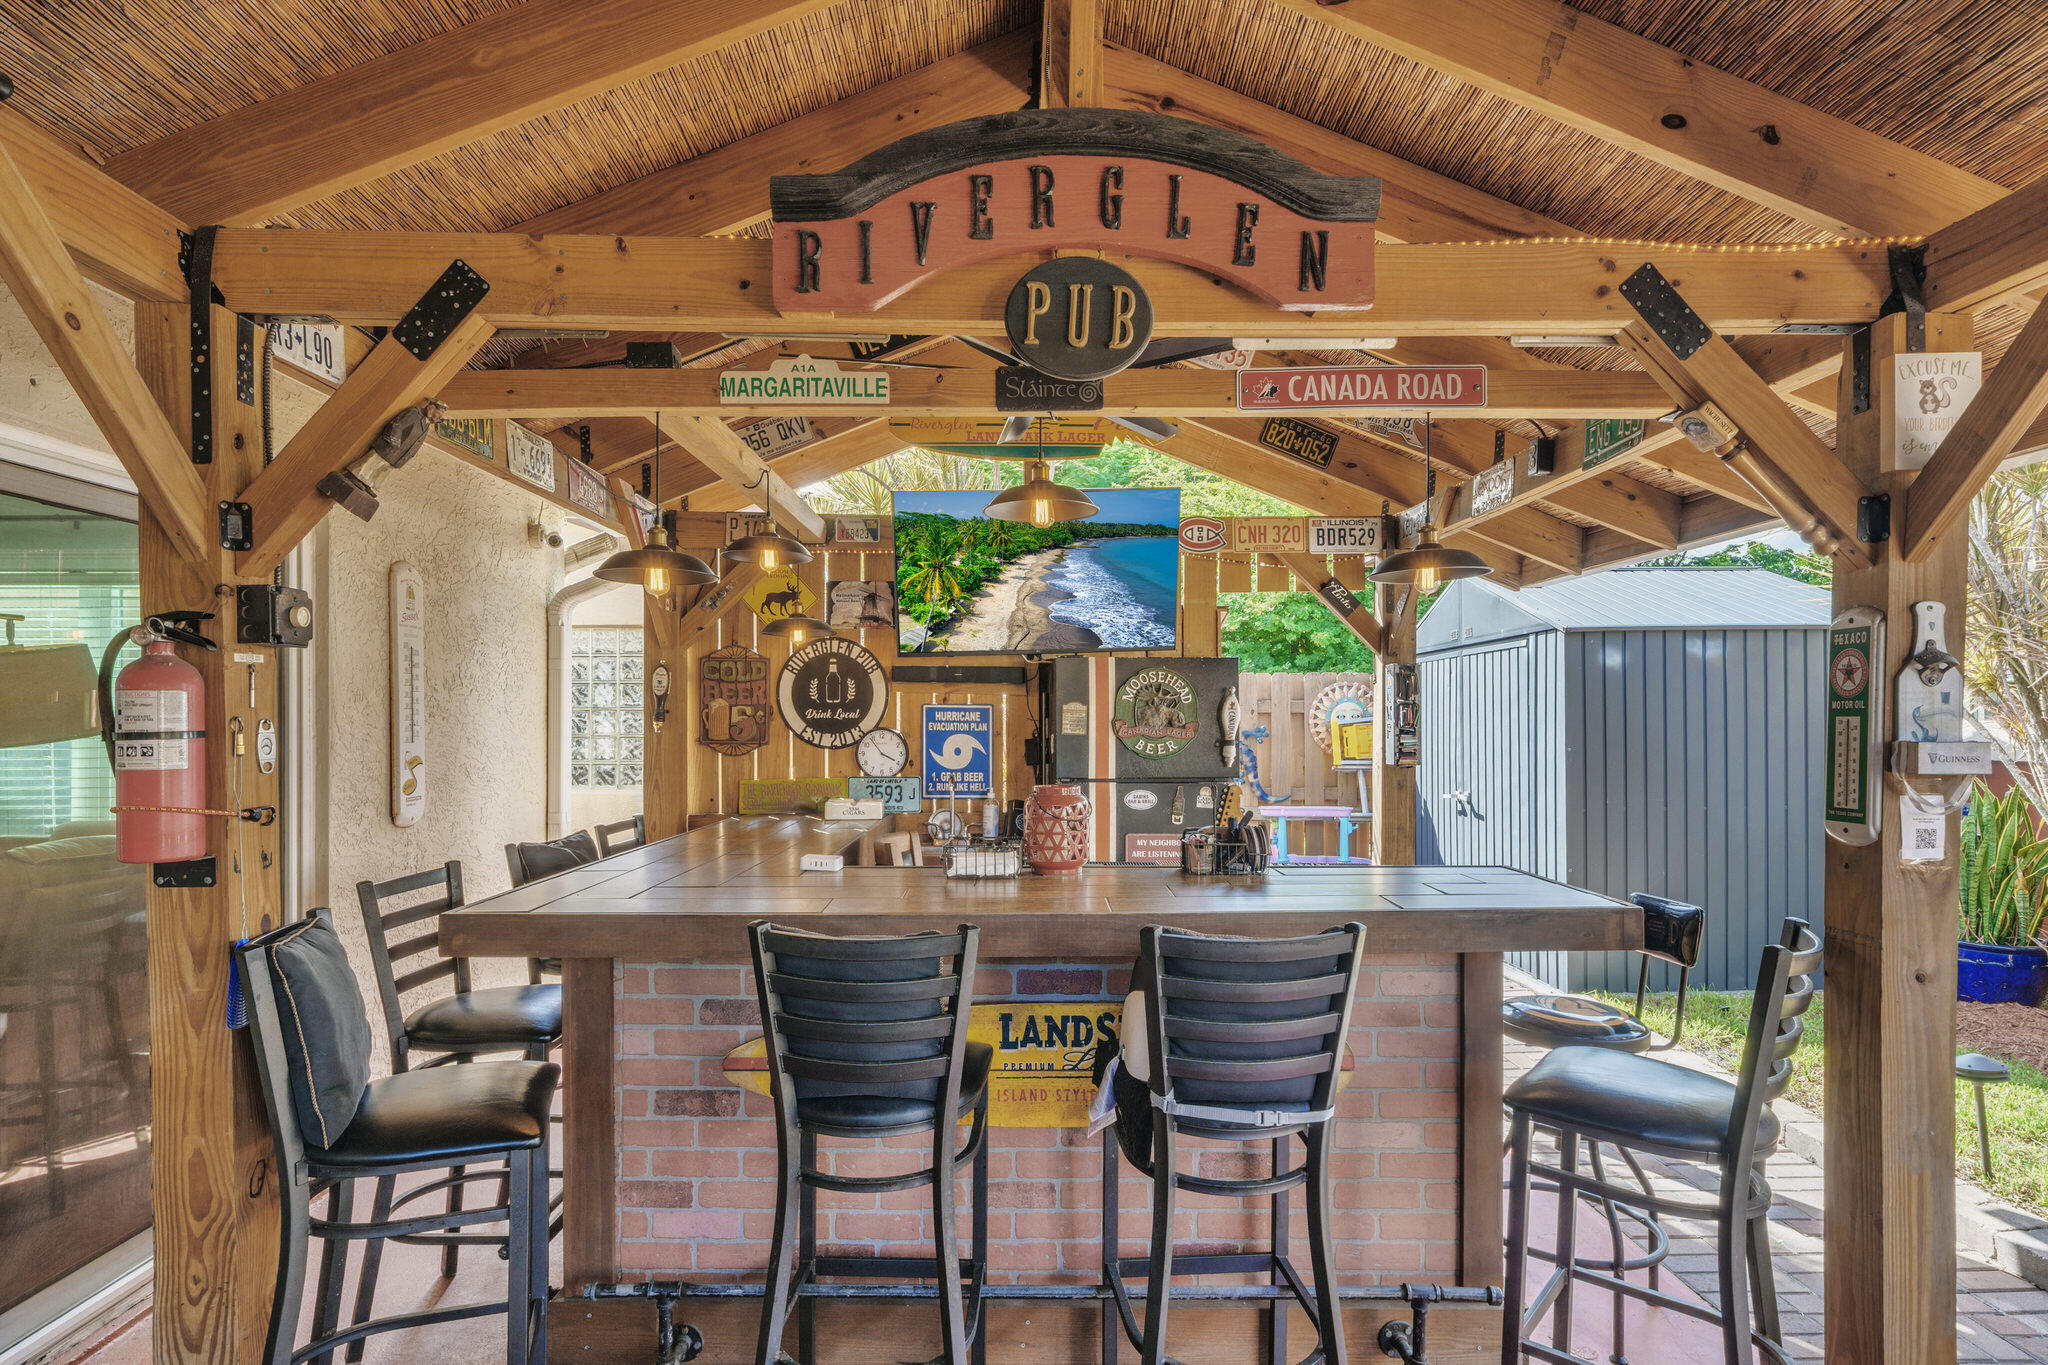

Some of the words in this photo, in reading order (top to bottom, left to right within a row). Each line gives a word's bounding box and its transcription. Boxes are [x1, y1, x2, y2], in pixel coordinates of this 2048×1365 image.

[796, 164, 1330, 294] RIVERGLEN
[1025, 280, 1137, 350] PUB
[791, 364, 816, 373] A1A
[1899, 357, 1946, 380] EXCUSE
[1950, 358, 1975, 380] ME
[721, 377, 887, 398] MARGARITAVILLE
[1005, 376, 1076, 398] Sláinte
[1288, 373, 1389, 402] CANADA
[1398, 373, 1462, 400] ROAD
[910, 416, 973, 431] Riverglen
[966, 430, 1056, 444] LANARK
[1058, 431, 1105, 443] LAGER
[1266, 423, 1296, 450] 820
[1300, 437, 1330, 464] 052
[1238, 525, 1267, 543] CNH
[1272, 525, 1301, 543] 320
[1316, 527, 1375, 546] BDR529
[1833, 631, 1867, 645] TEXACO
[785, 640, 854, 676] RIVERGLEN
[854, 649, 879, 675] PUB
[1121, 671, 1192, 705] MOOSEHEAD
[1832, 700, 1854, 709] MOTOR
[1854, 700, 1865, 709] OIL
[805, 708, 832, 719] Drink
[833, 708, 861, 720] Local
[935, 711, 981, 722] HURRICANE
[929, 722, 969, 732] EVACUATION
[970, 722, 988, 732] PLAN
[1134, 739, 1178, 755] BEER
[1938, 754, 1980, 763] GUINNESS
[963, 772, 984, 782] BEER
[1136, 839, 1148, 847] MY
[1149, 839, 1181, 847] NEIGHBO
[1132, 850, 1147, 858] ARE
[1148, 850, 1181, 858] LISTENIN
[999, 1012, 1122, 1050] LANDS
[1003, 1062, 1055, 1071] PREMIUM
[997, 1088, 1048, 1103] ISLAND
